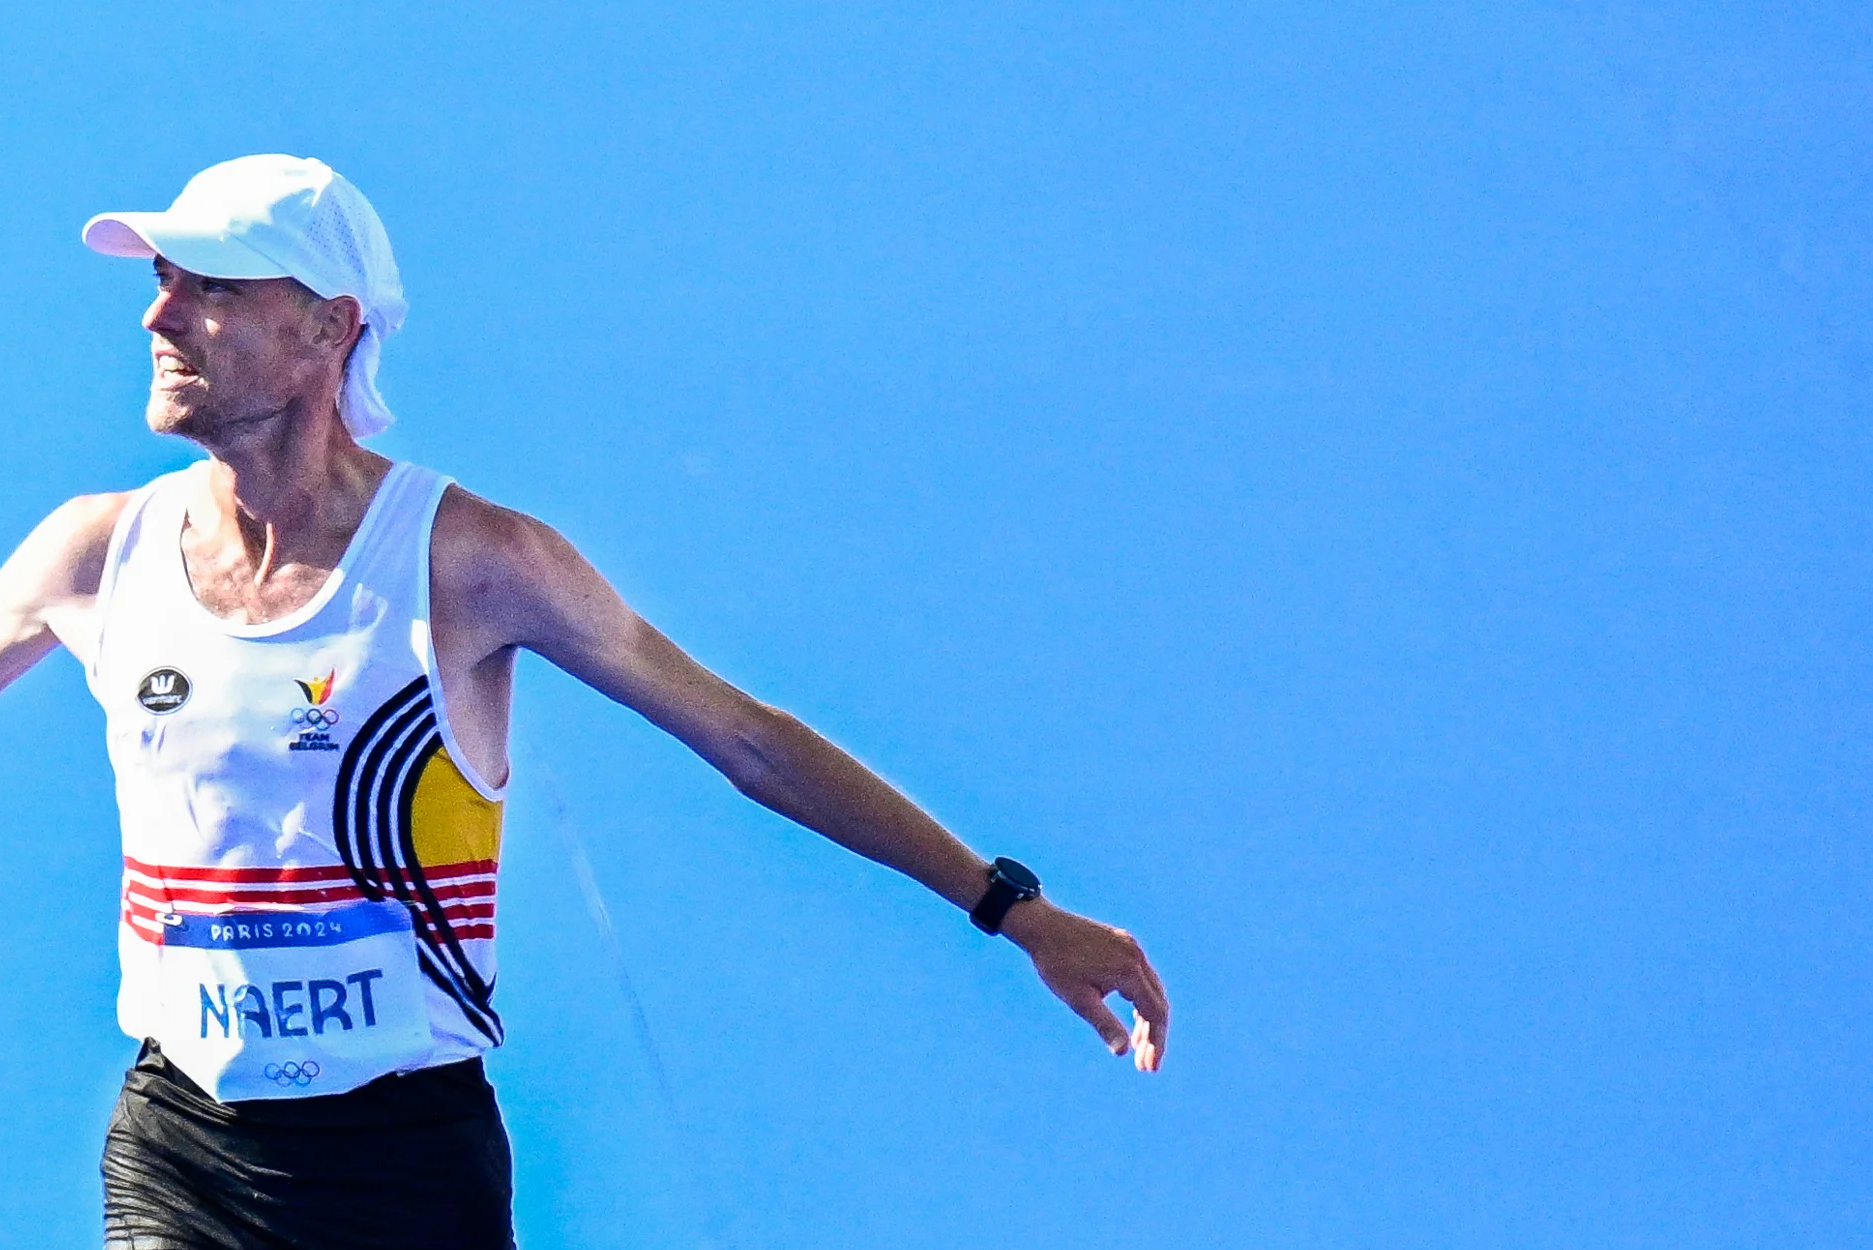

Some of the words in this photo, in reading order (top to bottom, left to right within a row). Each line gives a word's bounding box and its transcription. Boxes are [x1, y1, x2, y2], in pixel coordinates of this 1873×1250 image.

[211, 923, 273, 941] PARIS
[283, 921, 342, 937] 2024
[199, 968, 383, 1038] NAERT
